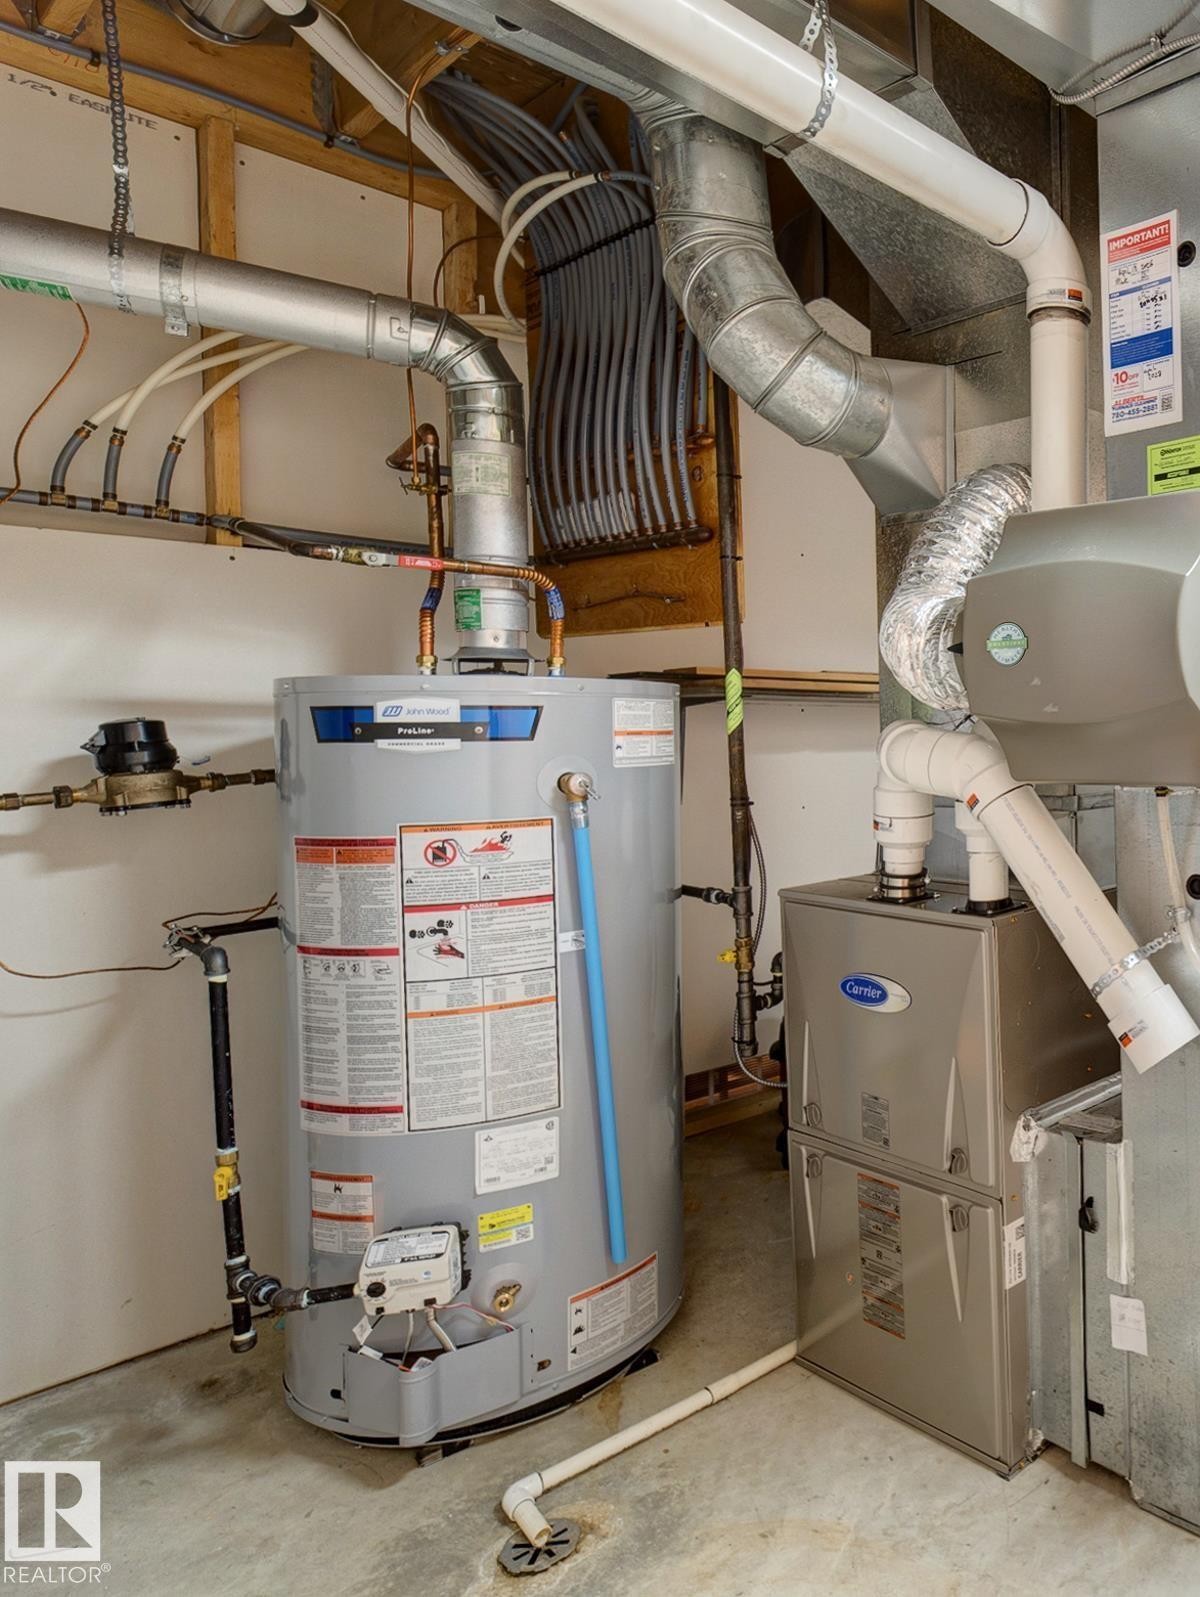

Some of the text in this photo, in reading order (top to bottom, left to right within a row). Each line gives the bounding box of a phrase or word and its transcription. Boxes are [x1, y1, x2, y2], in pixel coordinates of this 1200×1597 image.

[1109, 223, 1169, 252] IMPORTANT!
[405, 708, 424, 716] John
[425, 707, 449, 716] Wood
[846, 981, 882, 999] Carrier
